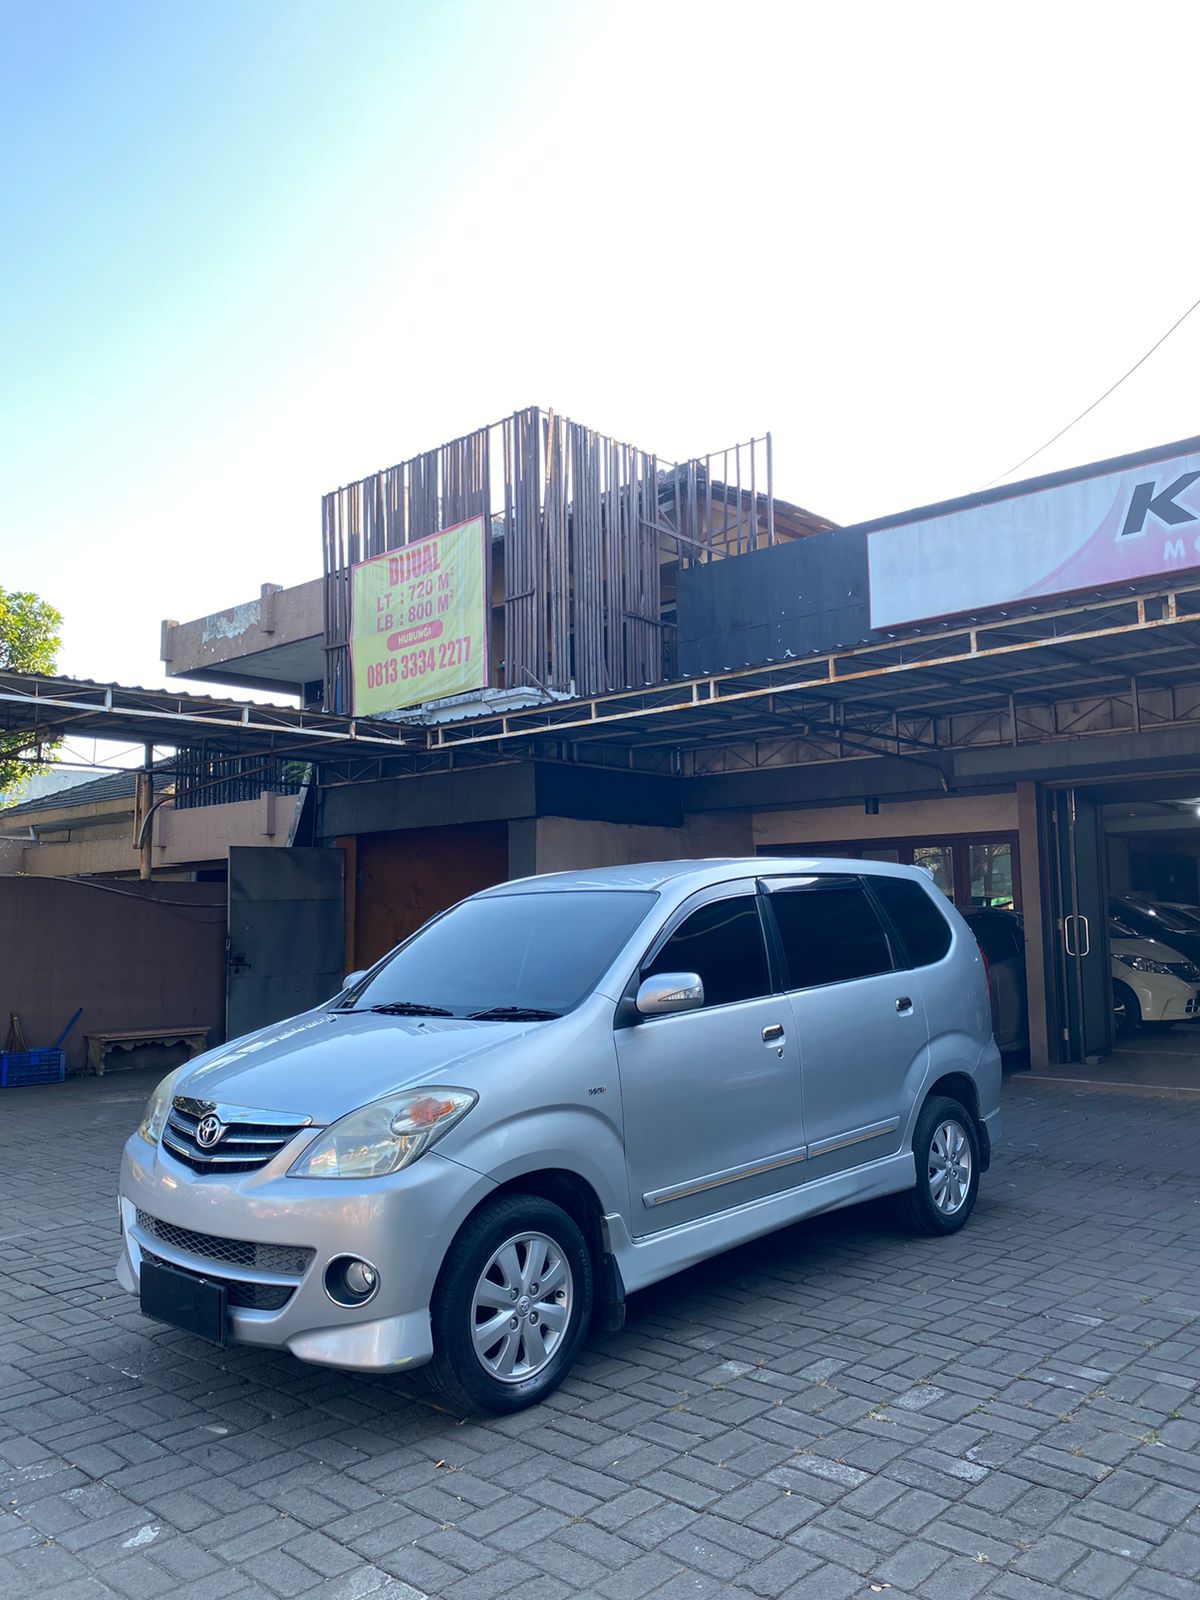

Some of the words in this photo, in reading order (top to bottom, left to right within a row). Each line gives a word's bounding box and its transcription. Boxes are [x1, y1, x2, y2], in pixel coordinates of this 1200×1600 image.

[376, 592, 392, 613] LT
[409, 579, 433, 602] 720
[376, 614, 393, 633] LB
[408, 600, 433, 623] 800
[398, 626, 432, 645] HUBUNGI
[367, 658, 398, 689] 0813
[400, 646, 436, 680] 3334
[438, 635, 471, 670] 2277
